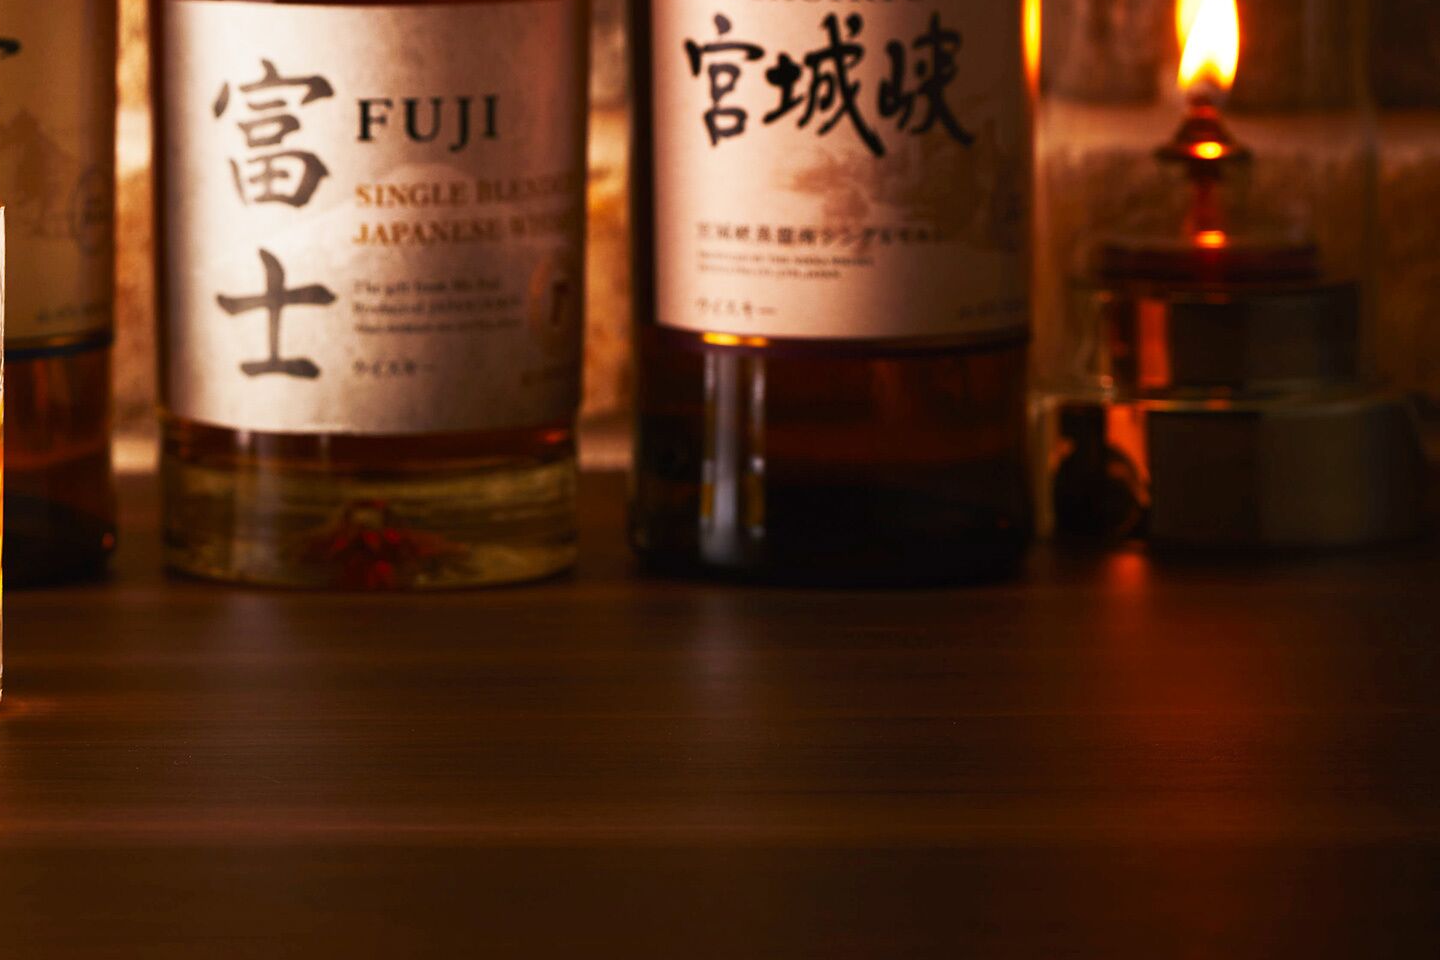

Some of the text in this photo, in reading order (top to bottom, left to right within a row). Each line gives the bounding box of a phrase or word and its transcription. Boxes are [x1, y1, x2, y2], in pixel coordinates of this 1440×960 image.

[684, 12, 975, 158] 宮城峡
[354, 94, 501, 152] FUJI
[213, 58, 338, 379] 富士
[355, 183, 468, 208] SINGLE
[353, 216, 501, 245] JAPANESE
